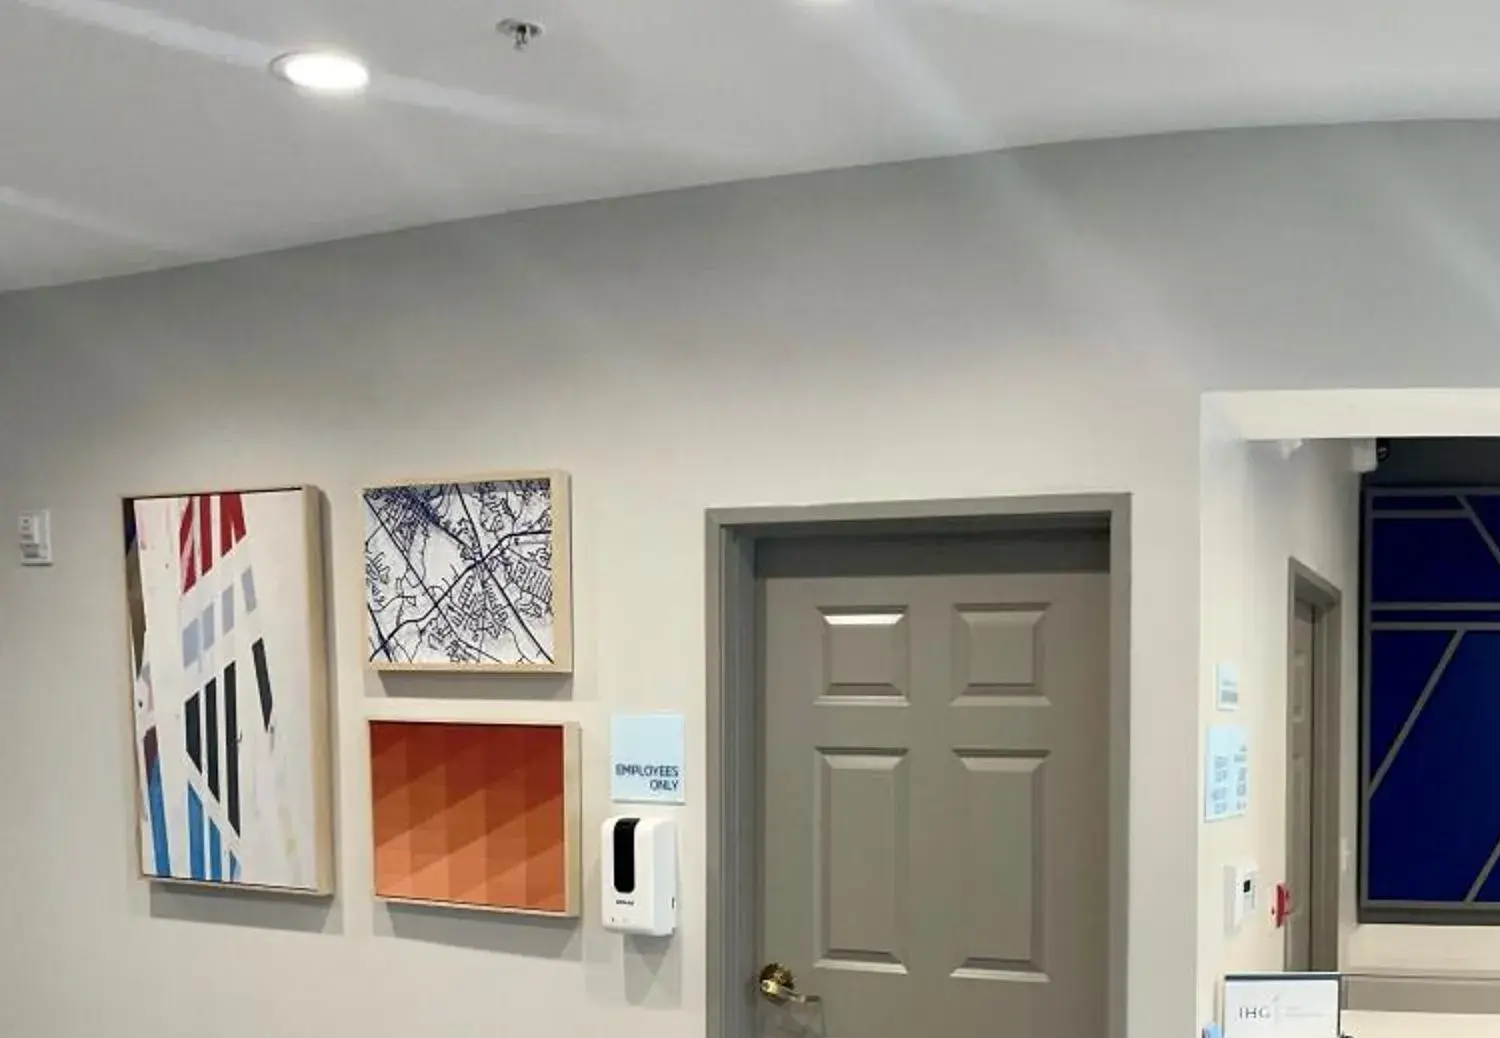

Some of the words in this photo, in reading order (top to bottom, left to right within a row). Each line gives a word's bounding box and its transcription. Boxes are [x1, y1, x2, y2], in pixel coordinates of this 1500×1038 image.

[615, 763, 679, 777] EMPLOYEES
[650, 779, 679, 791] ONLY
[1239, 1005, 1271, 1020] IHG
